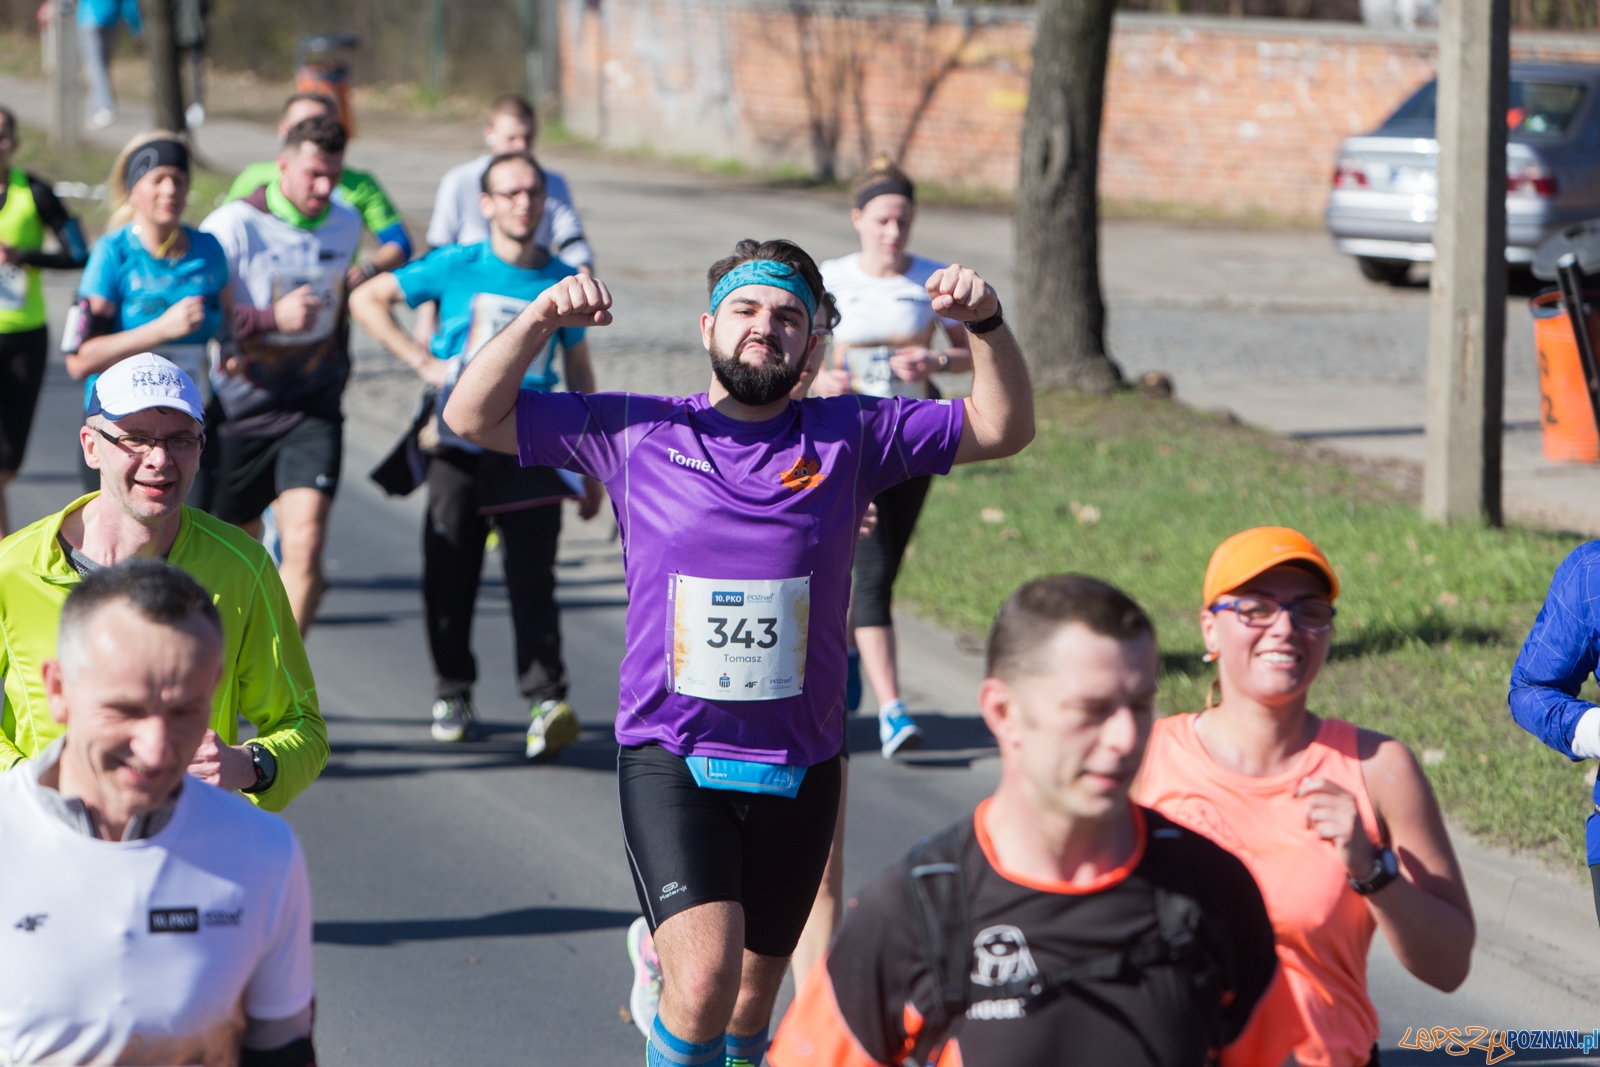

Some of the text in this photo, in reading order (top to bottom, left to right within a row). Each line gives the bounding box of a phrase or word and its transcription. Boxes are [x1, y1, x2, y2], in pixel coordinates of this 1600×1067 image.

[667, 447, 715, 474] Tome
[706, 616, 779, 649] 343
[723, 653, 762, 663] Tomasz
